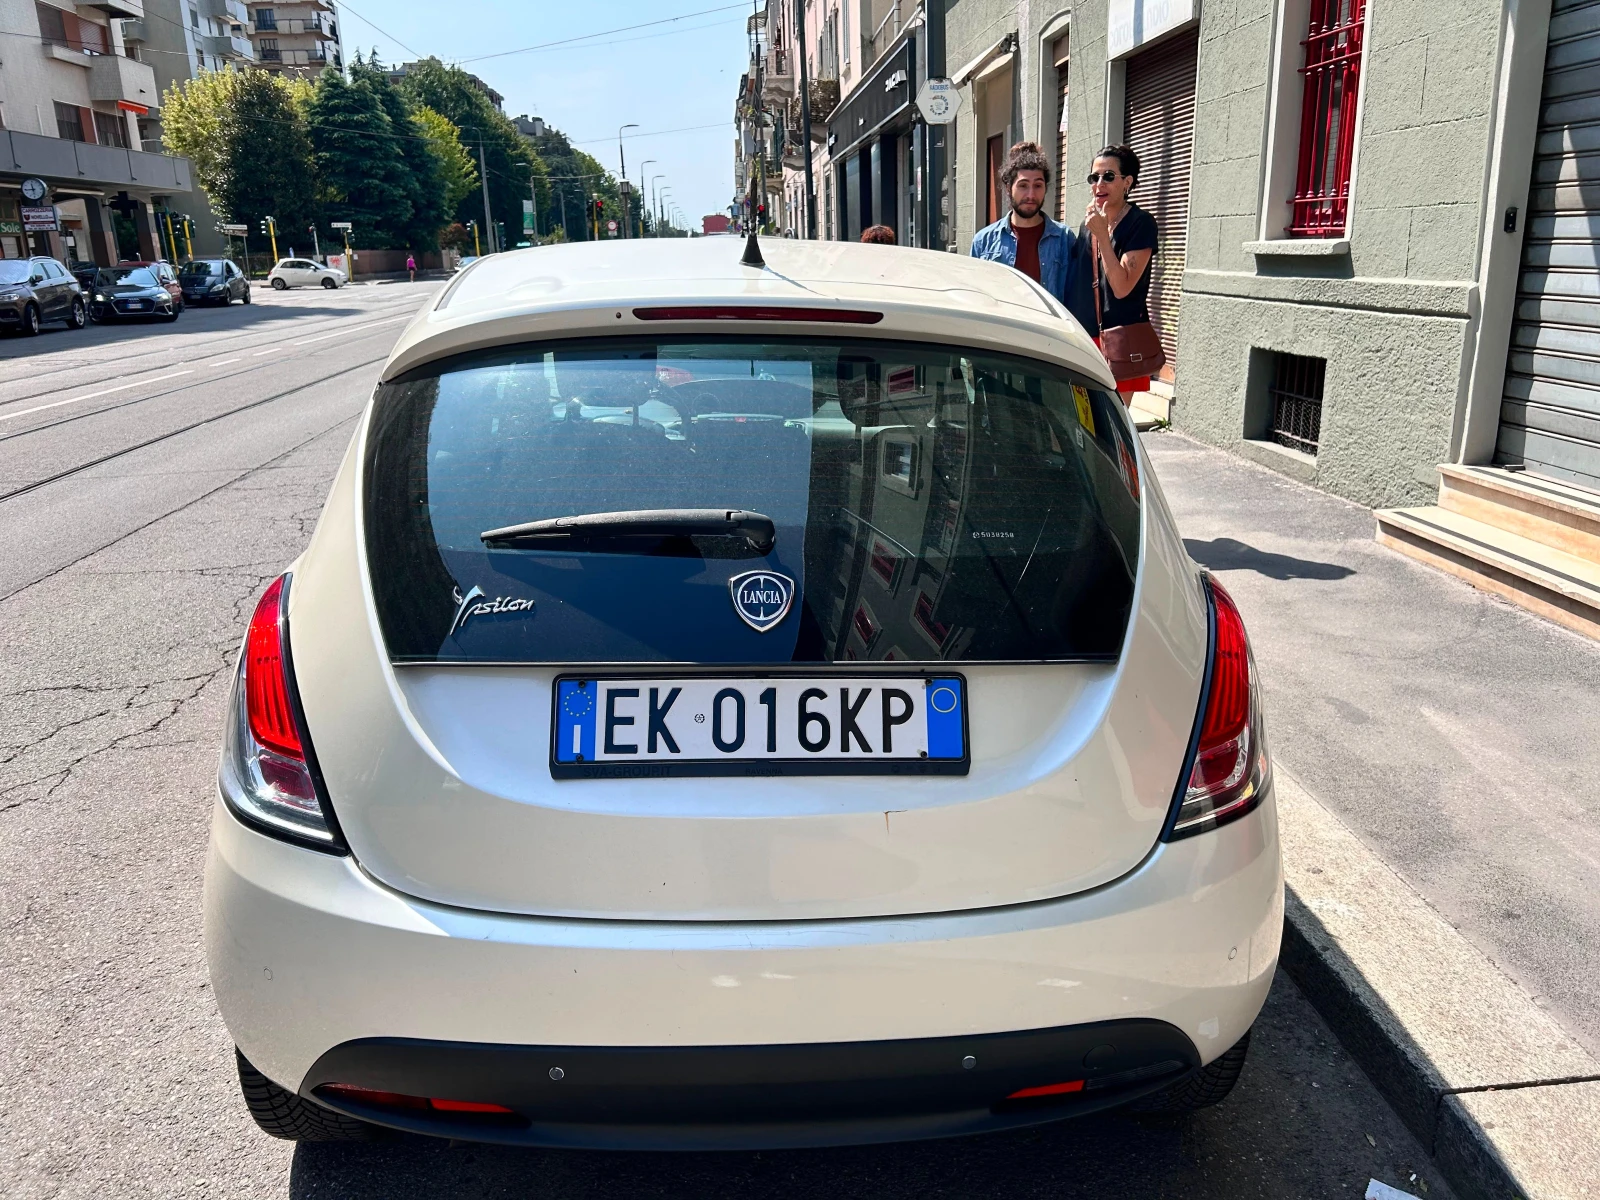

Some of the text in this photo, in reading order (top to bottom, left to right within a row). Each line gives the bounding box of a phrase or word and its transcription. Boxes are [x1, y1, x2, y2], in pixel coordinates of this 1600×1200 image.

[0, 222, 20, 232] Sole
[744, 590, 781, 604] LANCIA
[450, 585, 535, 635] Ypsilon
[603, 687, 915, 754] EK 016KP
[745, 767, 783, 776] RAVENNA
